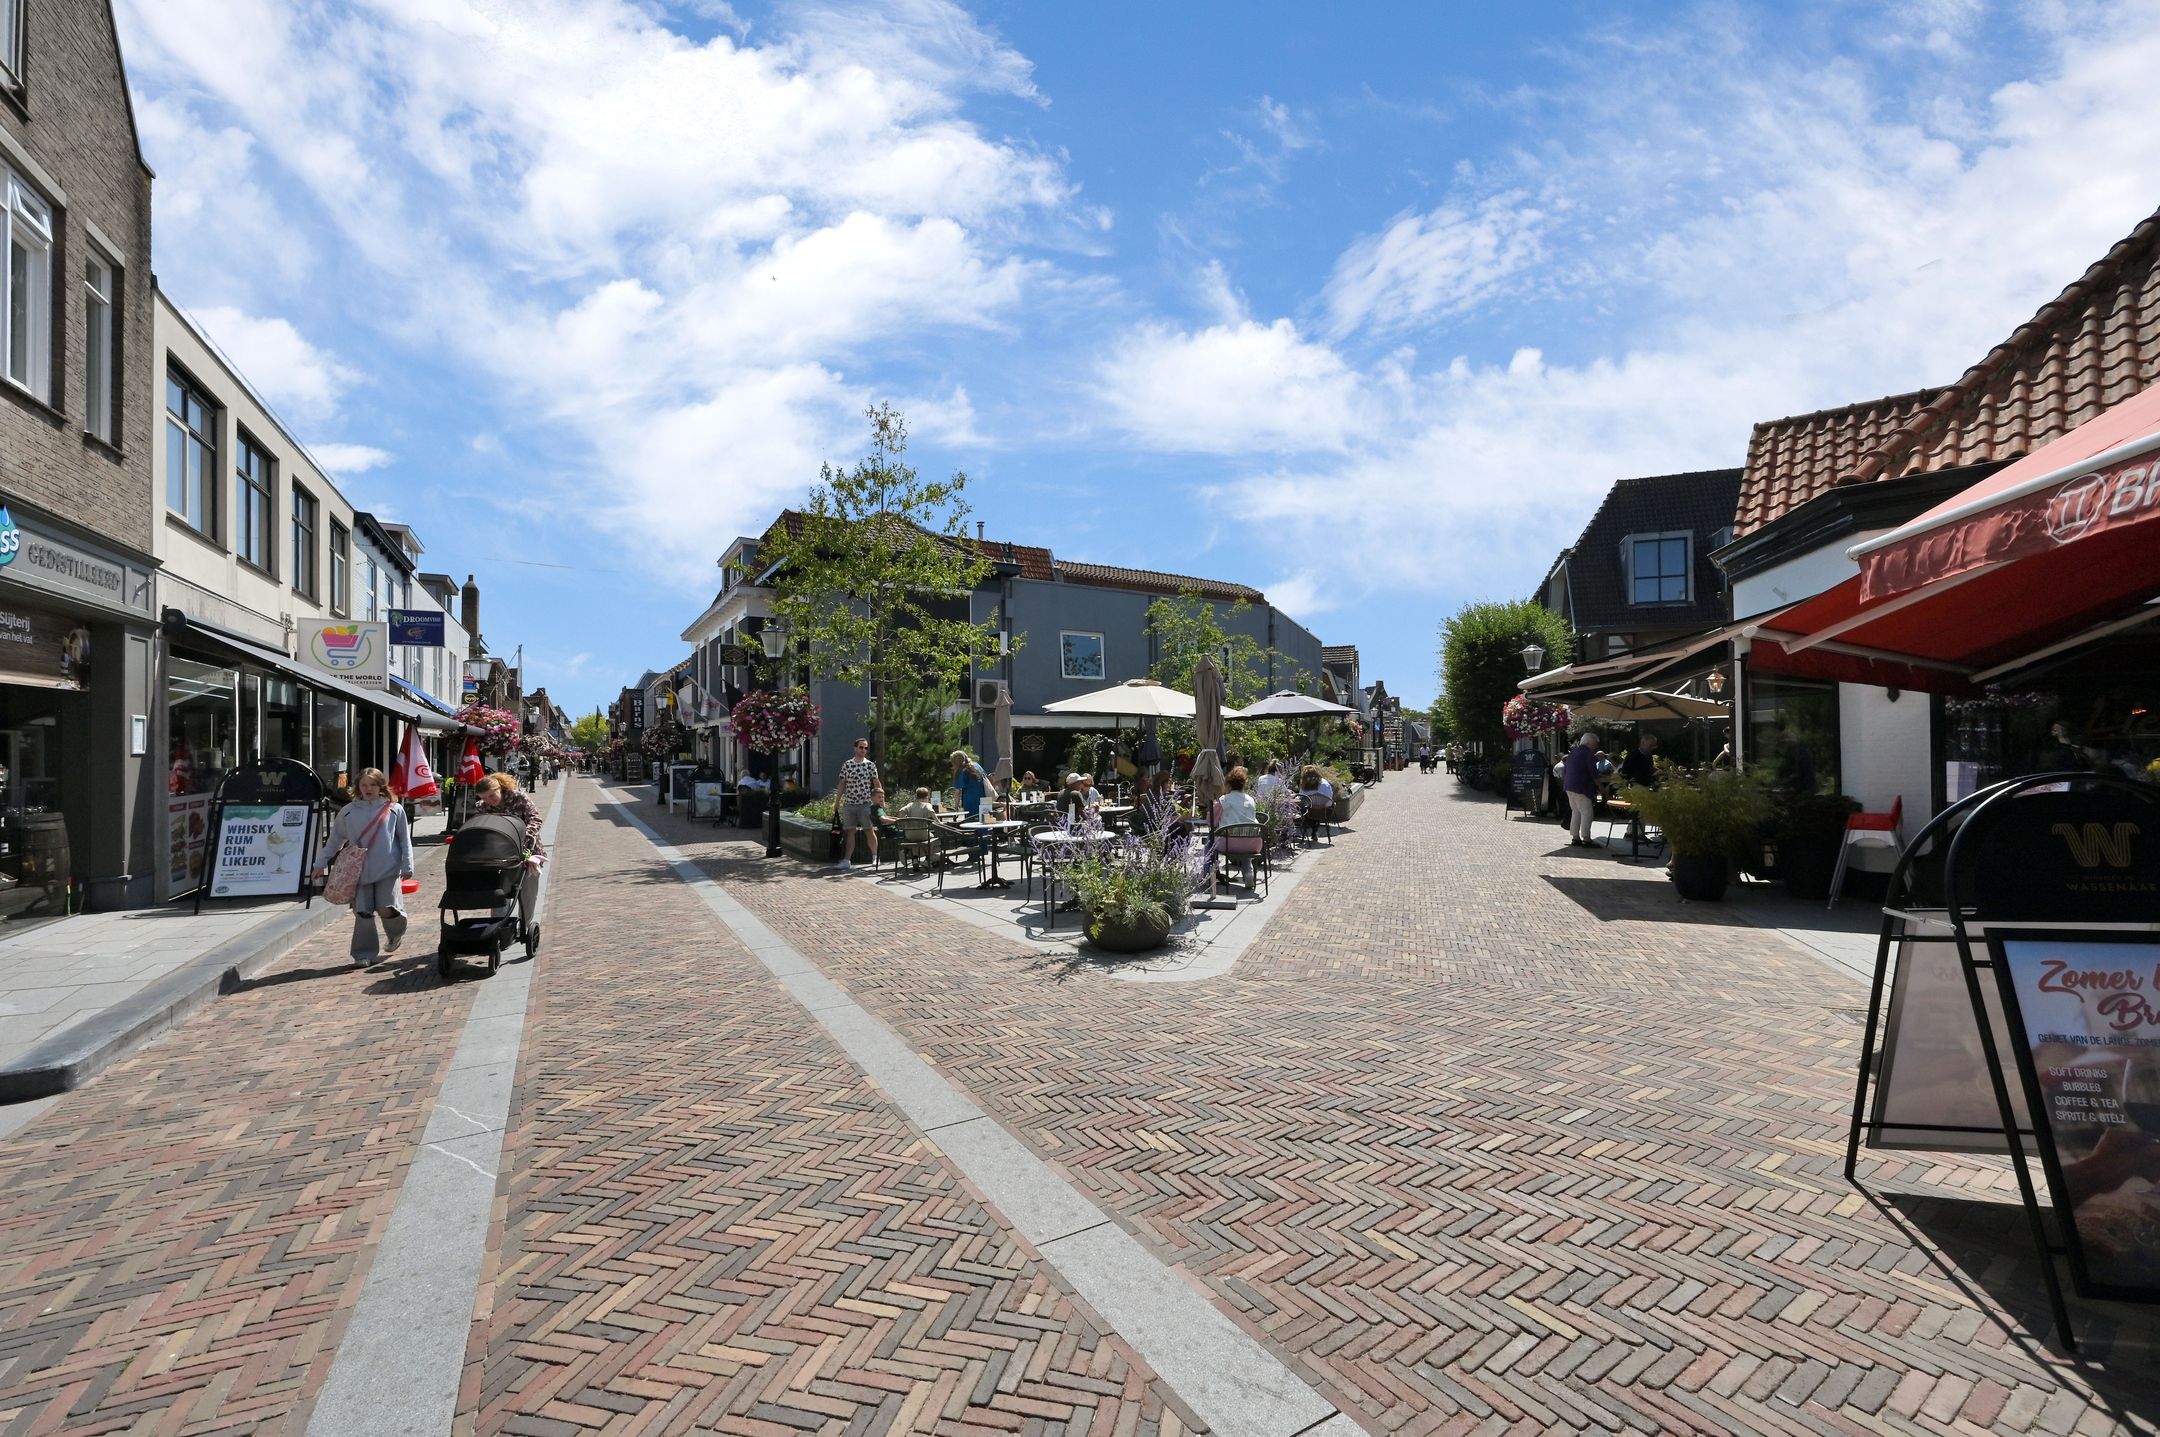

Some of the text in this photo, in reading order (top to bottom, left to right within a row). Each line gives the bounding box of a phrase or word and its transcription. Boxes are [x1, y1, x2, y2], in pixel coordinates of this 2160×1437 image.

[227, 824, 275, 835] WHISKY
[225, 835, 254, 845] RUM
[223, 846, 246, 856] GIN
[222, 856, 266, 867] LIKEUR
[2038, 959, 2144, 1004] Zomer
[2070, 1035, 2089, 1045] VAN
[2090, 1036, 2102, 1045] DE
[2049, 1066, 2108, 1079] SOFT DRINKS
[2062, 1081, 2102, 1093] BUBBLES
[2055, 1096, 2120, 1109] COFFEE & TEA
[2056, 1110, 2087, 1121] SPRITZ
[2089, 1111, 2098, 1122] &
